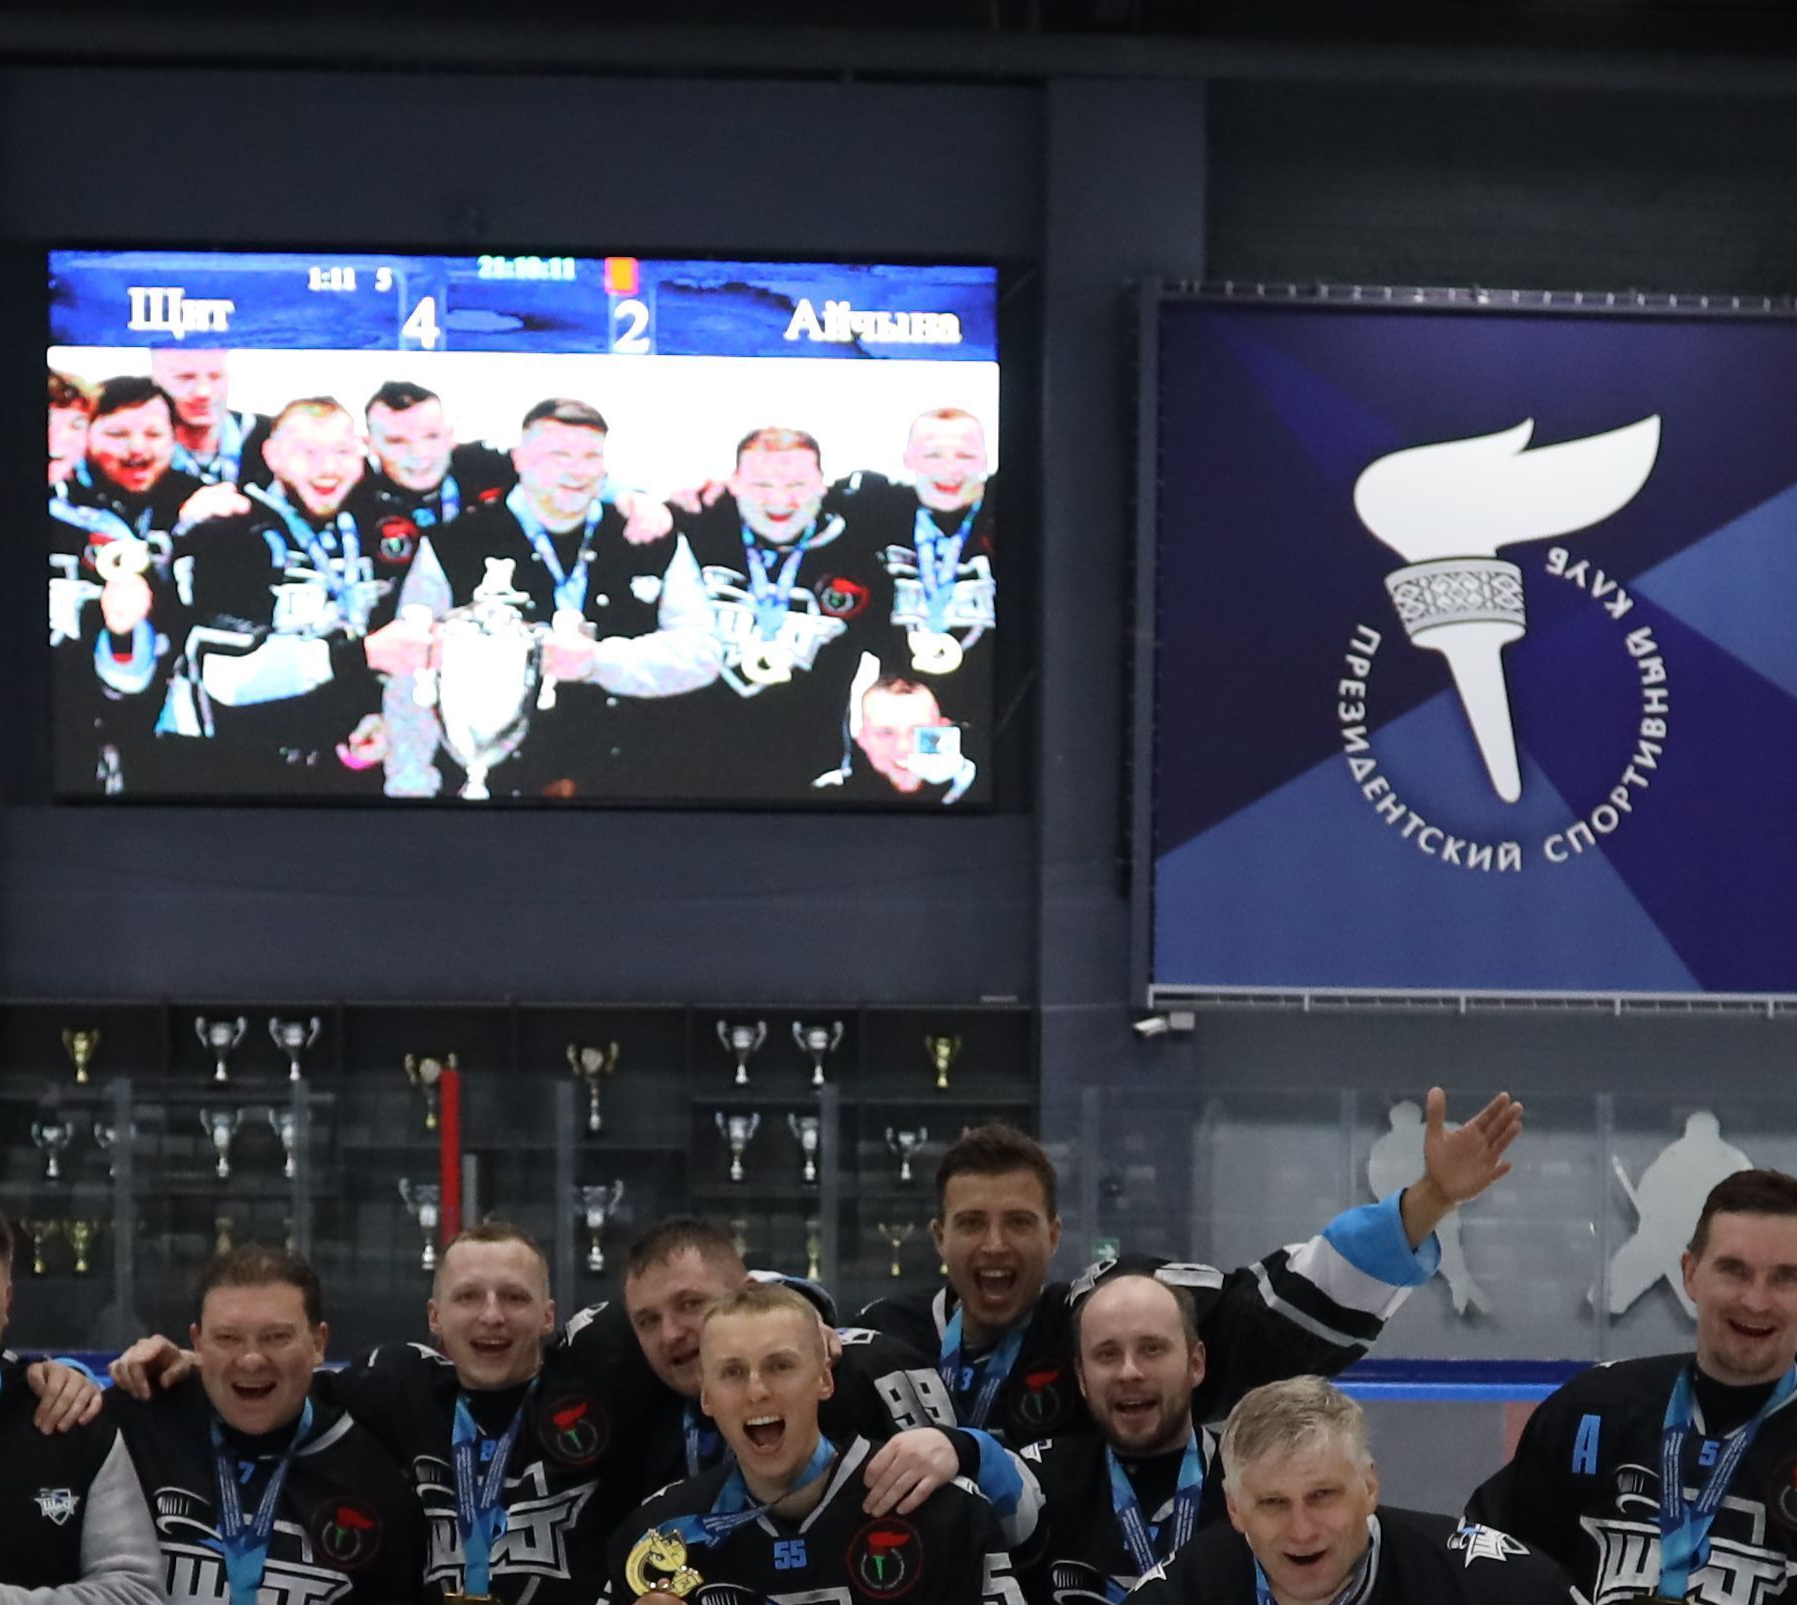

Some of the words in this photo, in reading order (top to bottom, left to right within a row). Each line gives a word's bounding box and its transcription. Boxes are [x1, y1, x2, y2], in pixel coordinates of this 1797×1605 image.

[126, 287, 236, 339] Щит
[401, 297, 441, 348] 4
[612, 300, 651, 354] 2
[782, 299, 963, 344] Айчына
[1545, 545, 1636, 620] КЛУБ
[1336, 623, 1523, 873] ПРЕЗИДЕНТСКИЙ
[1543, 625, 1670, 864] СПОРТИВНЫЙ
[1571, 1414, 1602, 1475] A
[772, 1539, 808, 1570] 55
